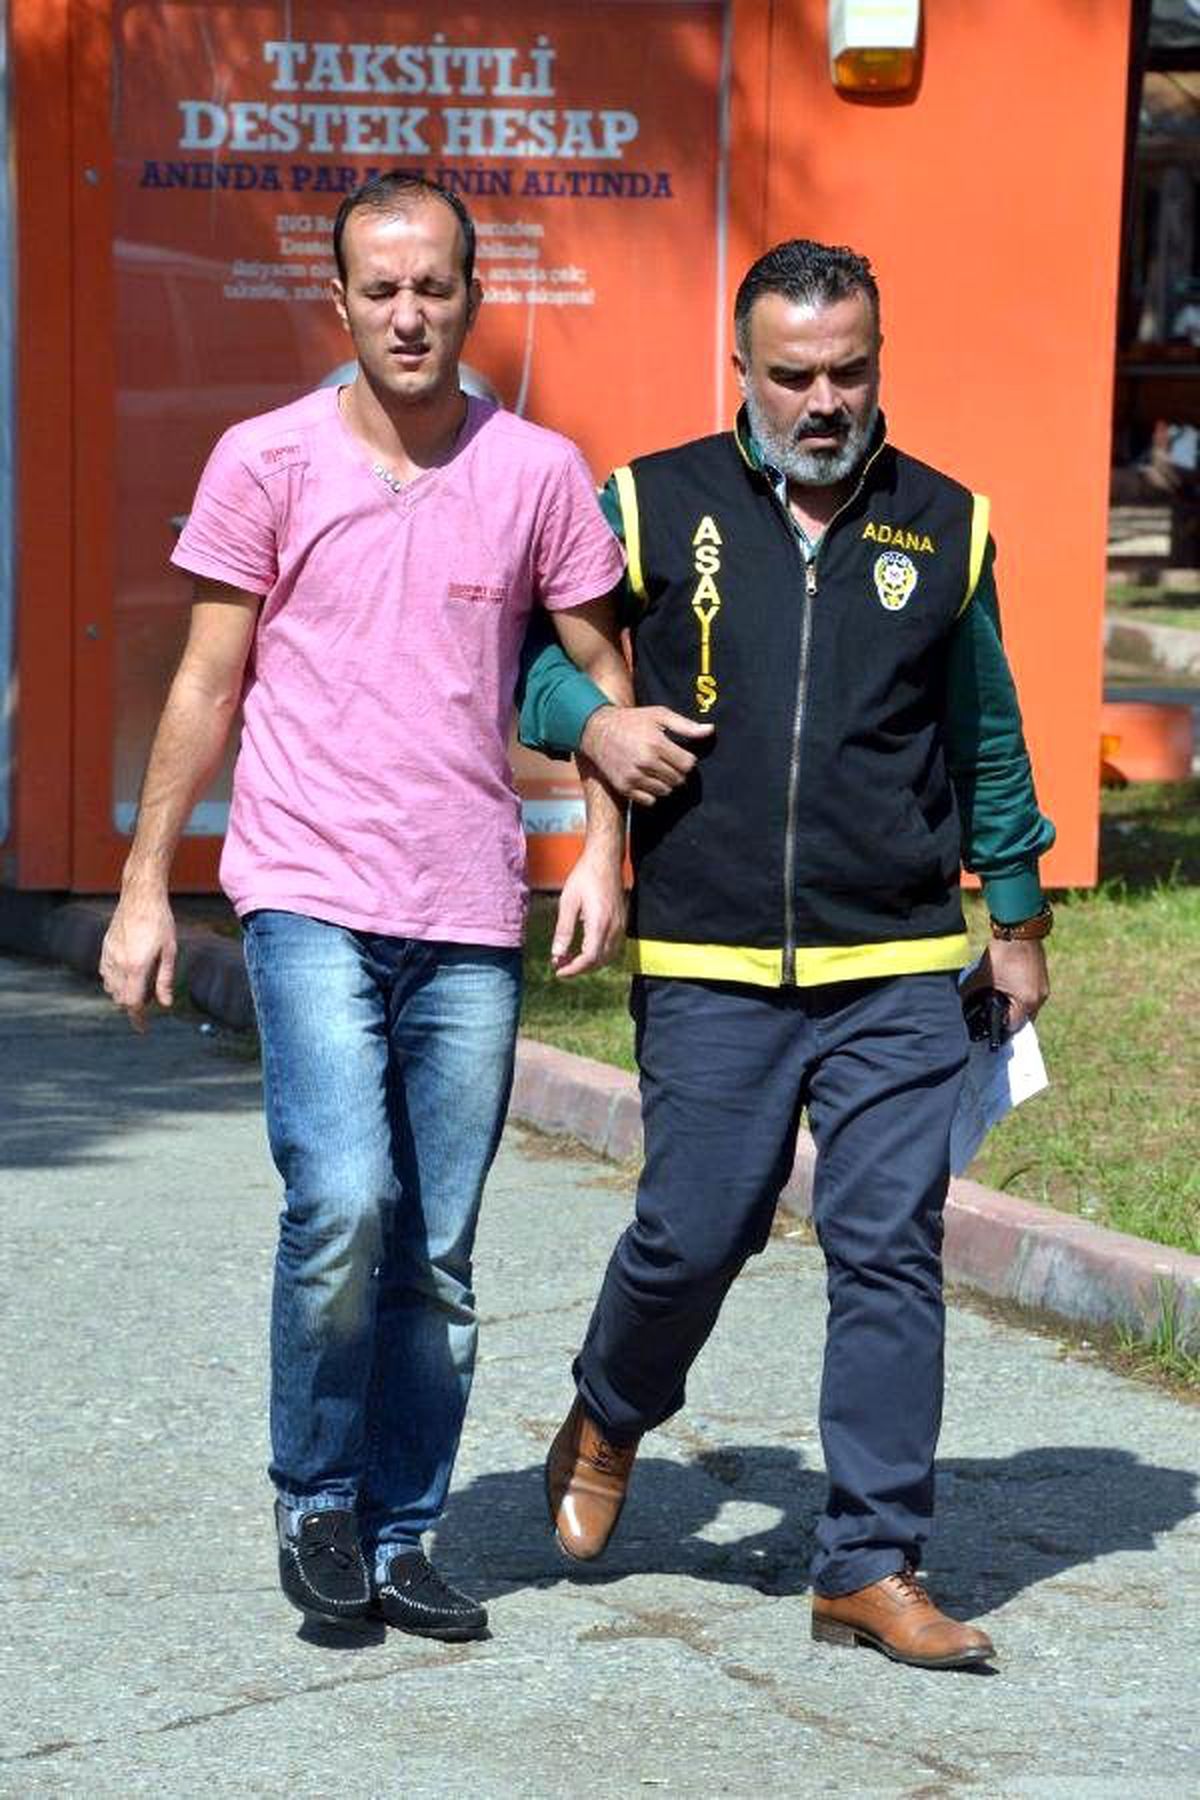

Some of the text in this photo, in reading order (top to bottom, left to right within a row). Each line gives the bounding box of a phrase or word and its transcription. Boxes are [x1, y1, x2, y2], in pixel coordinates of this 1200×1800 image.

[264, 34, 556, 97] TAKSİTLİ
[179, 101, 639, 159] DESTEK HESAP
[521, 170, 674, 199] ALTINDA
[862, 521, 935, 553] ADANA
